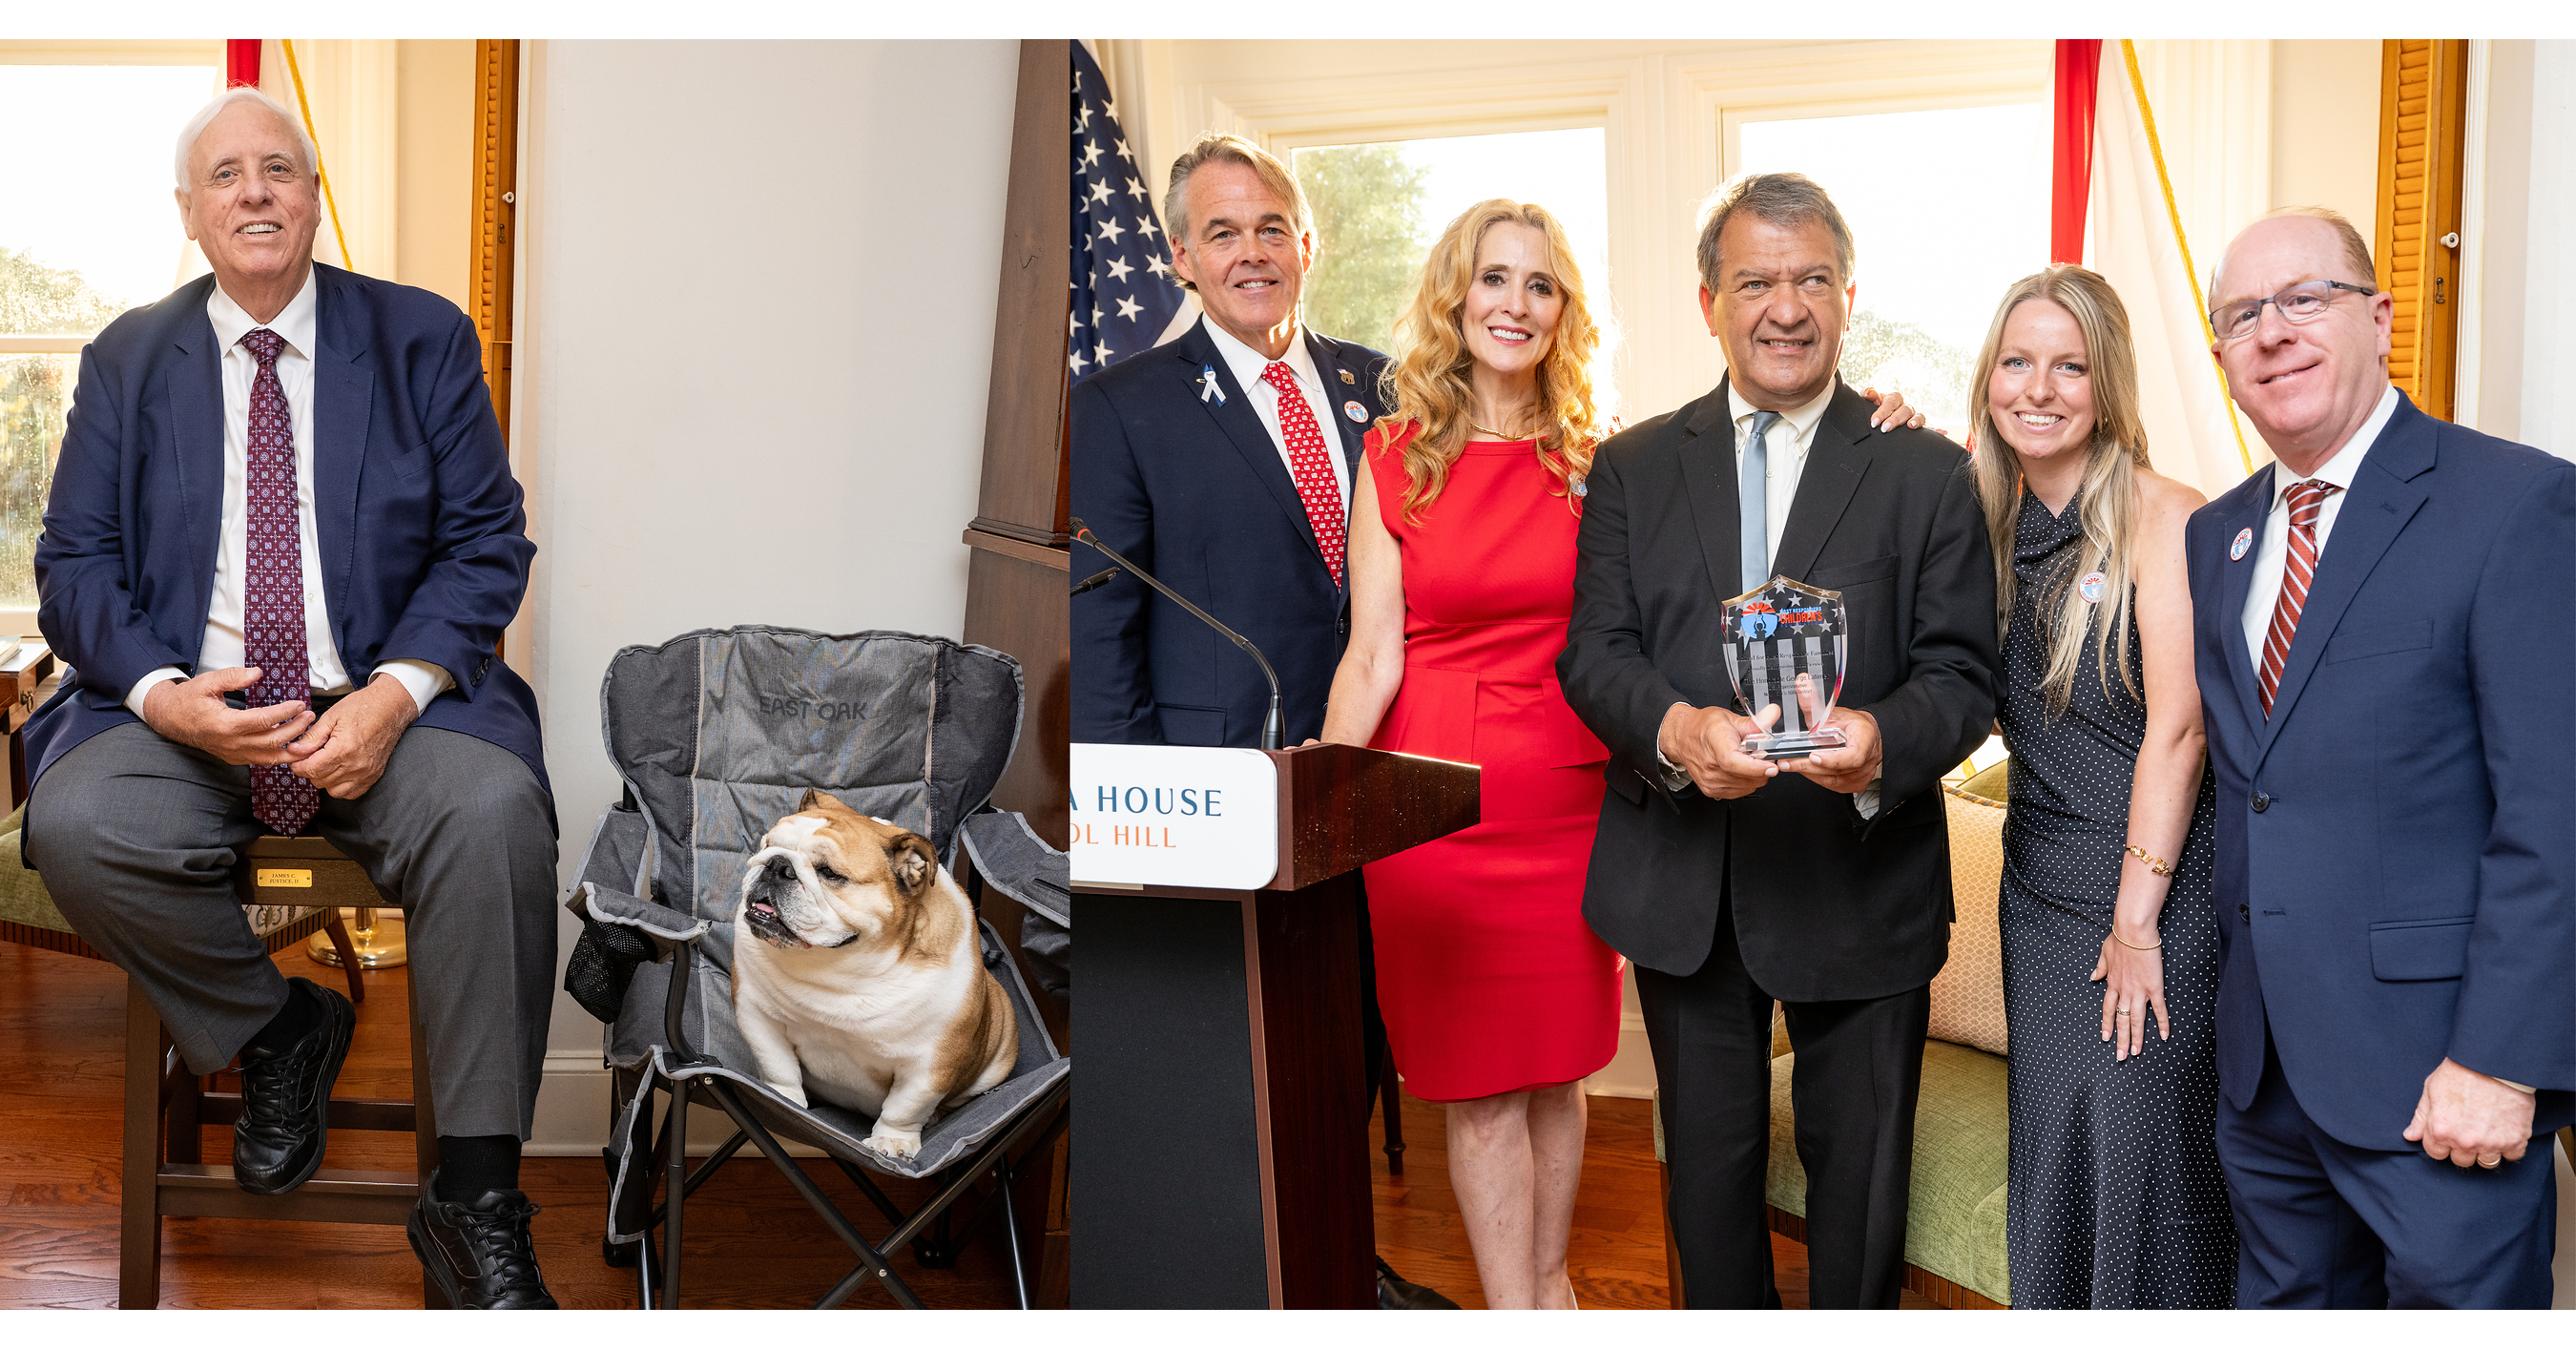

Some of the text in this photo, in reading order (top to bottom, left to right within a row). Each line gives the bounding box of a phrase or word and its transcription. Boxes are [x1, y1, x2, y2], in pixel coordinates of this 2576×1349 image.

[1779, 612, 1822, 624] CHILDREN'S
[759, 695, 867, 721] EAST OAK
[1097, 785, 1222, 817] HOUSE
[1114, 825, 1176, 848] HILL
